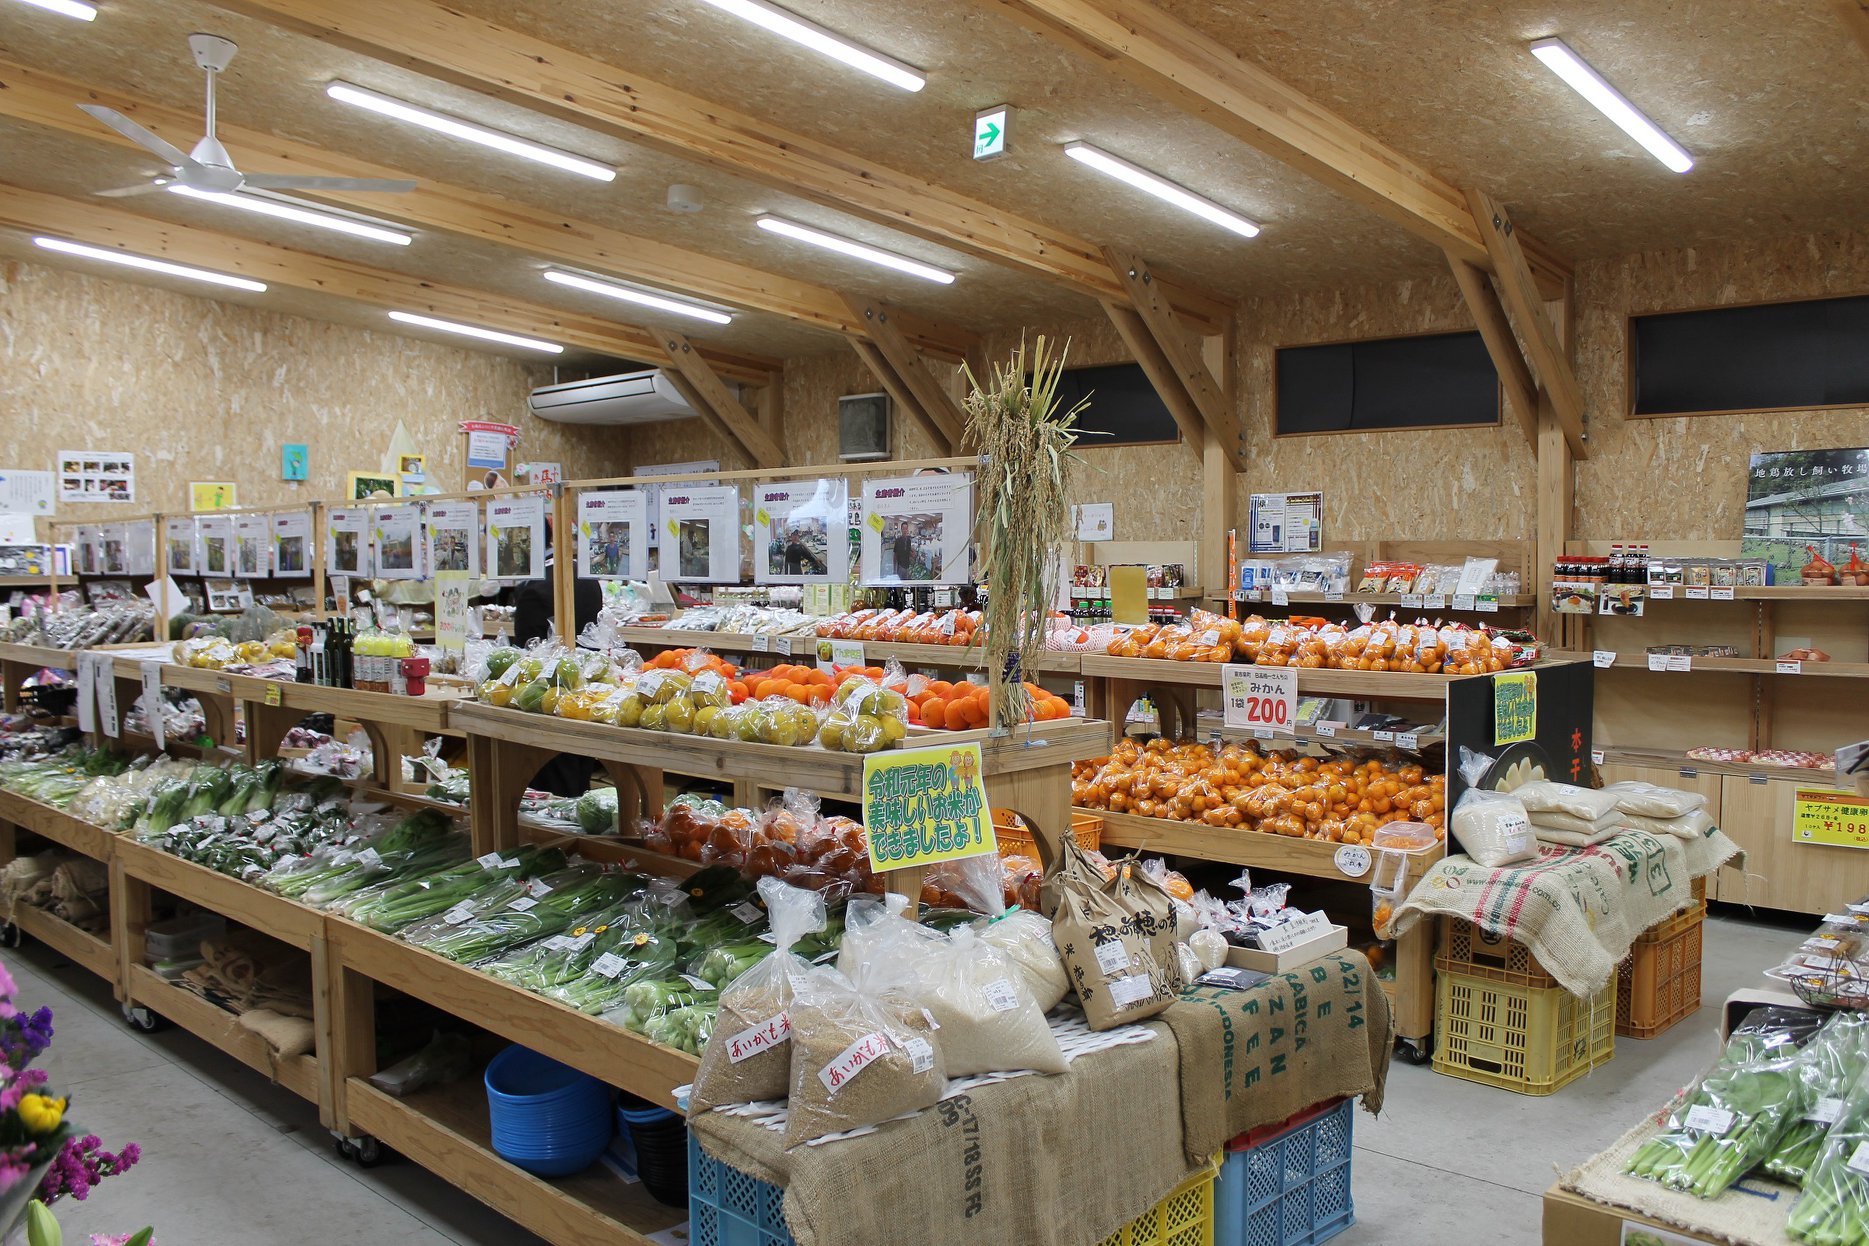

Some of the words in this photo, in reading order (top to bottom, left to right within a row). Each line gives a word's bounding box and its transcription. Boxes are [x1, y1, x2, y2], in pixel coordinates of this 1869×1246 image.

[1754, 463, 1868, 478] 地鶏放し飼い牧場
[1250, 682, 1286, 695] みかん
[1231, 698, 1245, 709] 1袋
[868, 761, 948, 801] 令和元年の
[867, 785, 982, 832] 美味しいお米が
[1805, 804, 1868, 816] ヤブサメ健康卵
[1343, 850, 1366, 860] みかん
[828, 1034, 889, 1088] あいがも米
